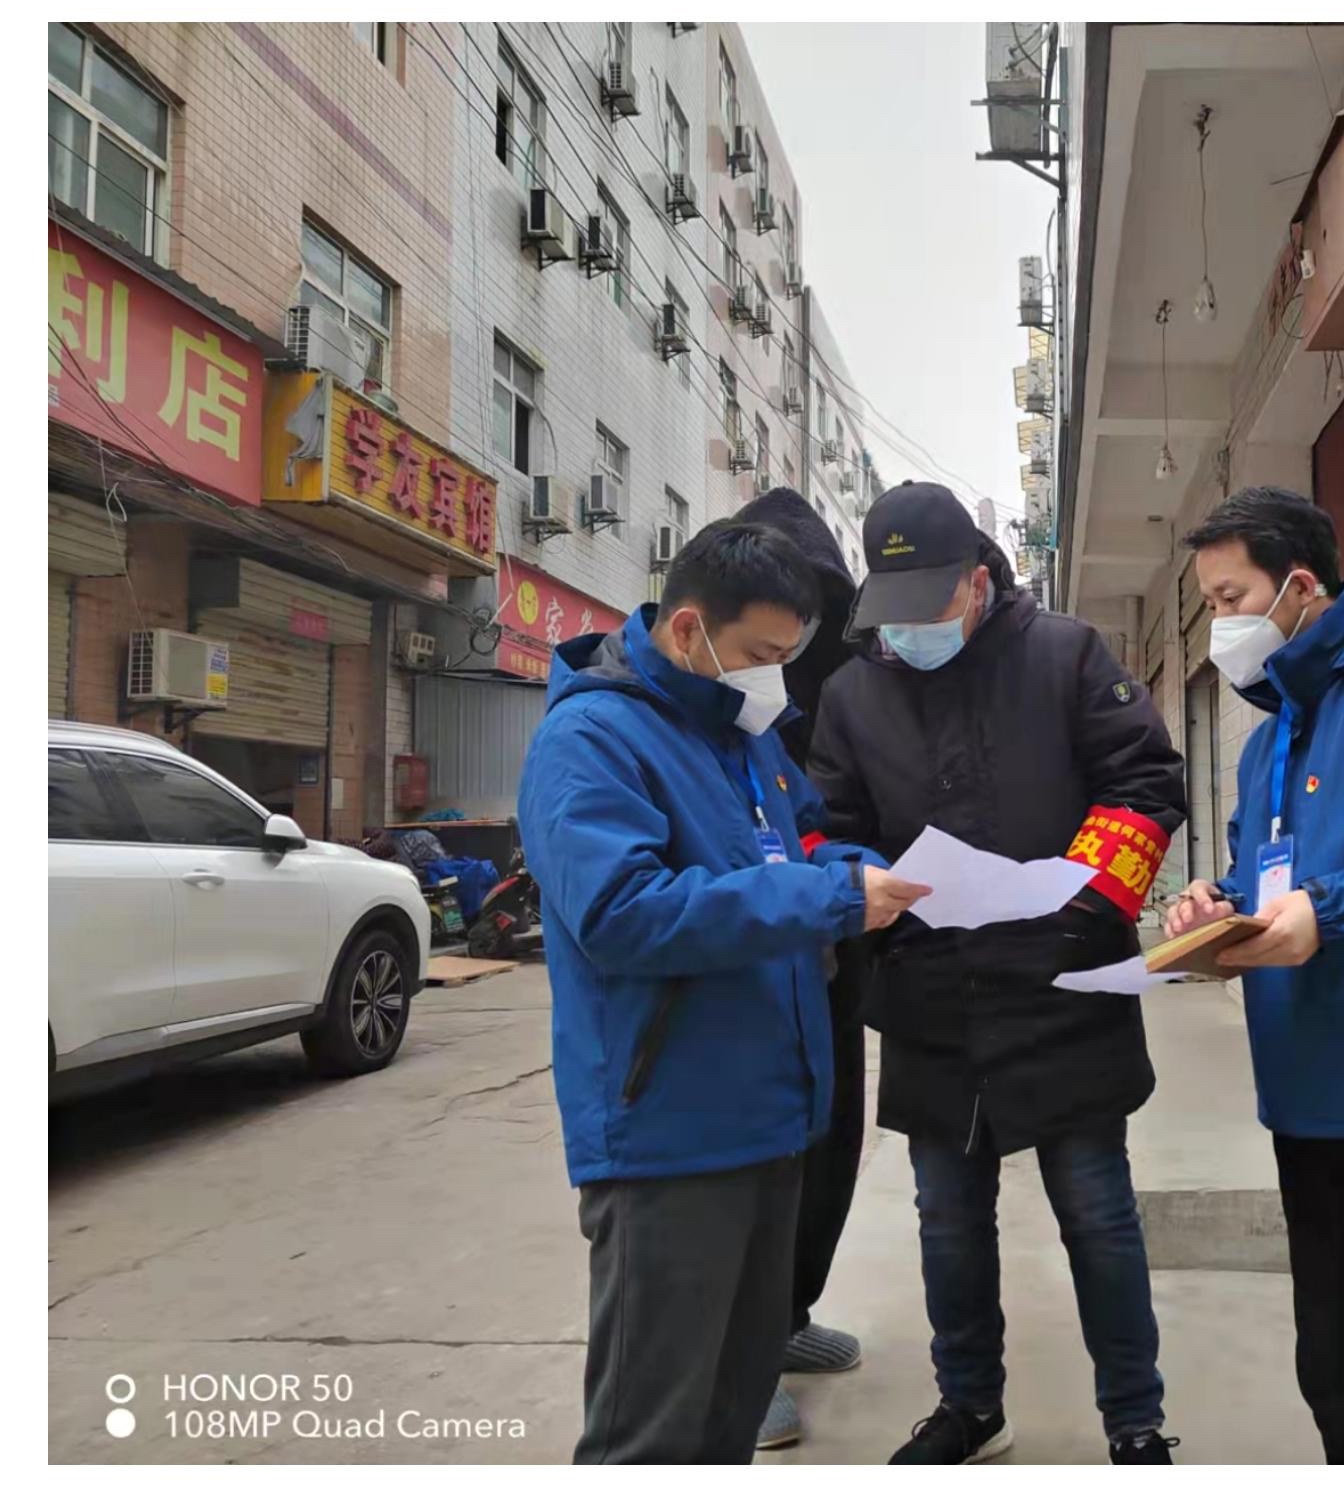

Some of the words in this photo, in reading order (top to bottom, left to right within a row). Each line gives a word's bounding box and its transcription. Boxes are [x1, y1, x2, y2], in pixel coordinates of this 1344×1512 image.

[344, 408, 491, 555] 学友宾馆
[1064, 829, 1152, 896] 执勤
